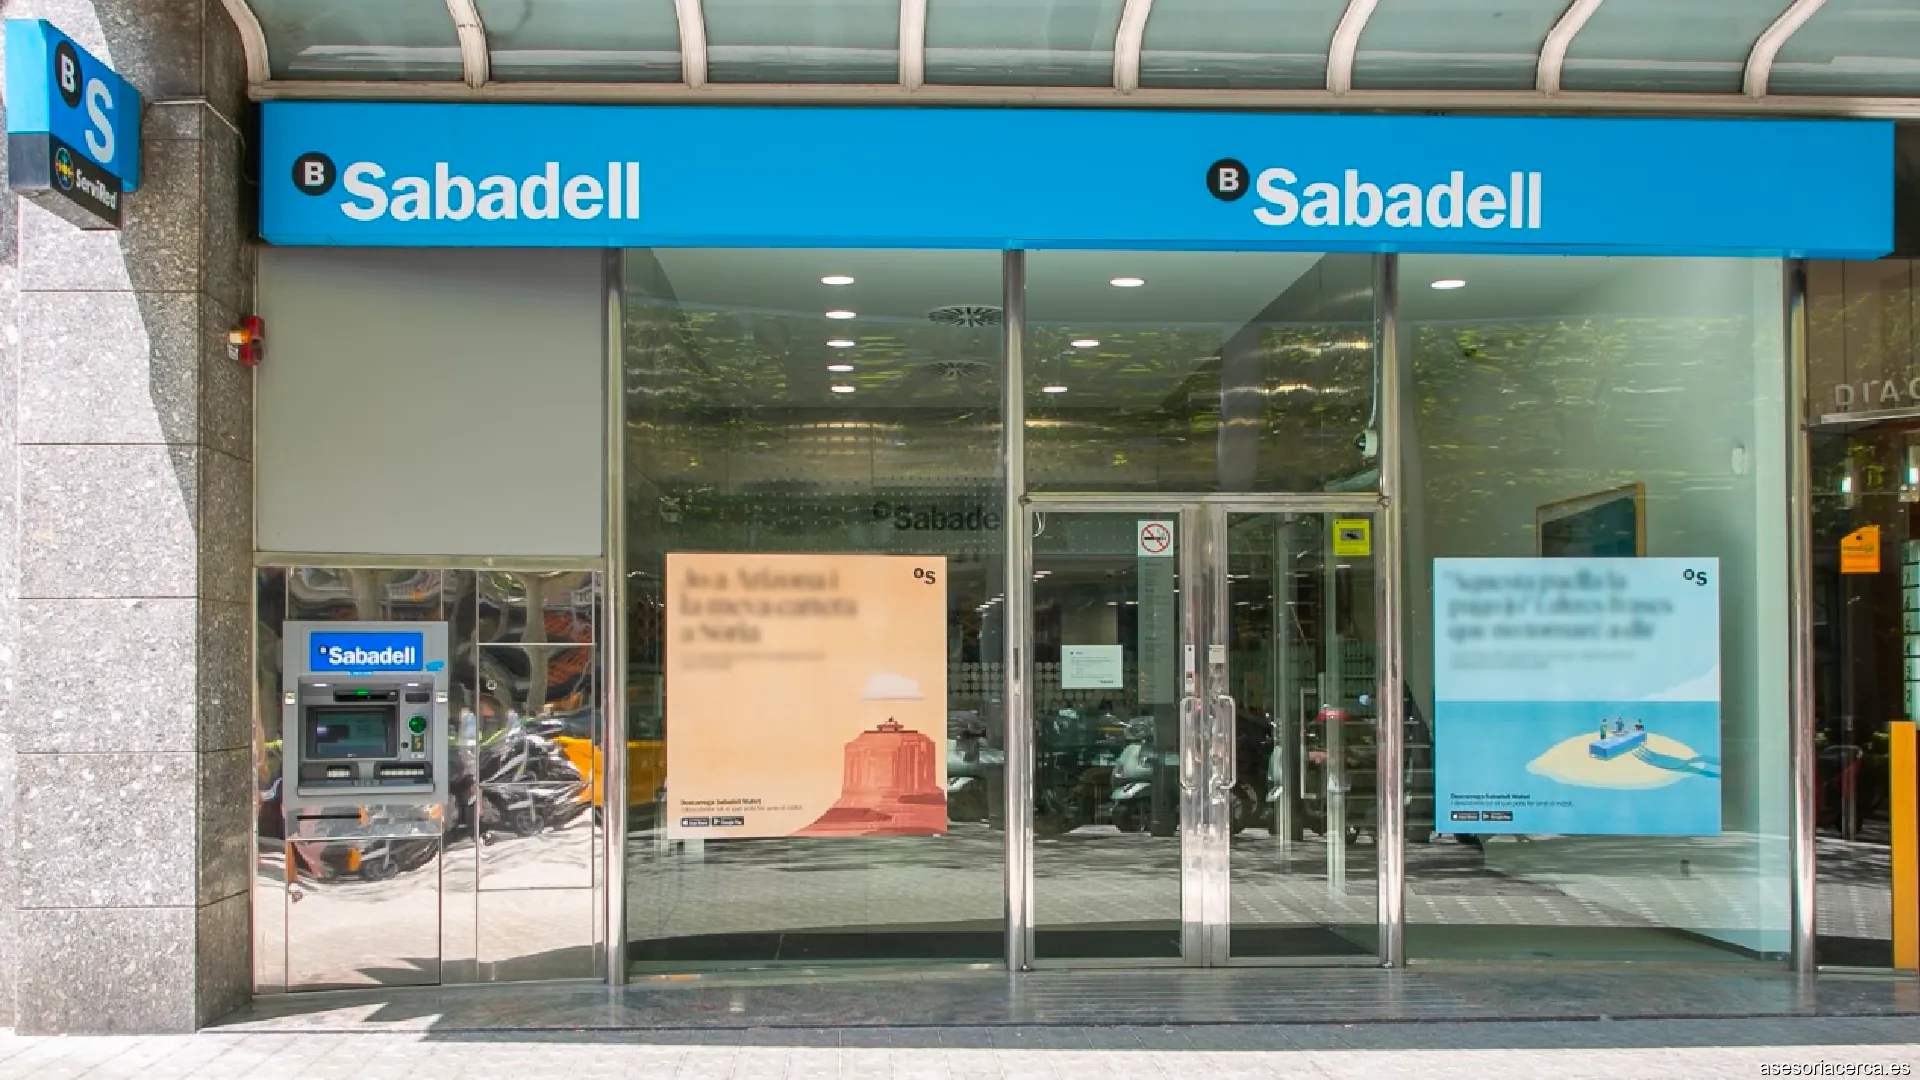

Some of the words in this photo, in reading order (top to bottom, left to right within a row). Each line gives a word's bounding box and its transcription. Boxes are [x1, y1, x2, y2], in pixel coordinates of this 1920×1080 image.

[85, 78, 115, 163] S
[340, 161, 641, 221] Sabadell
[1253, 167, 1542, 228] Sabadell
[893, 506, 1003, 531] Sabade
[328, 646, 416, 665] Sabadell
